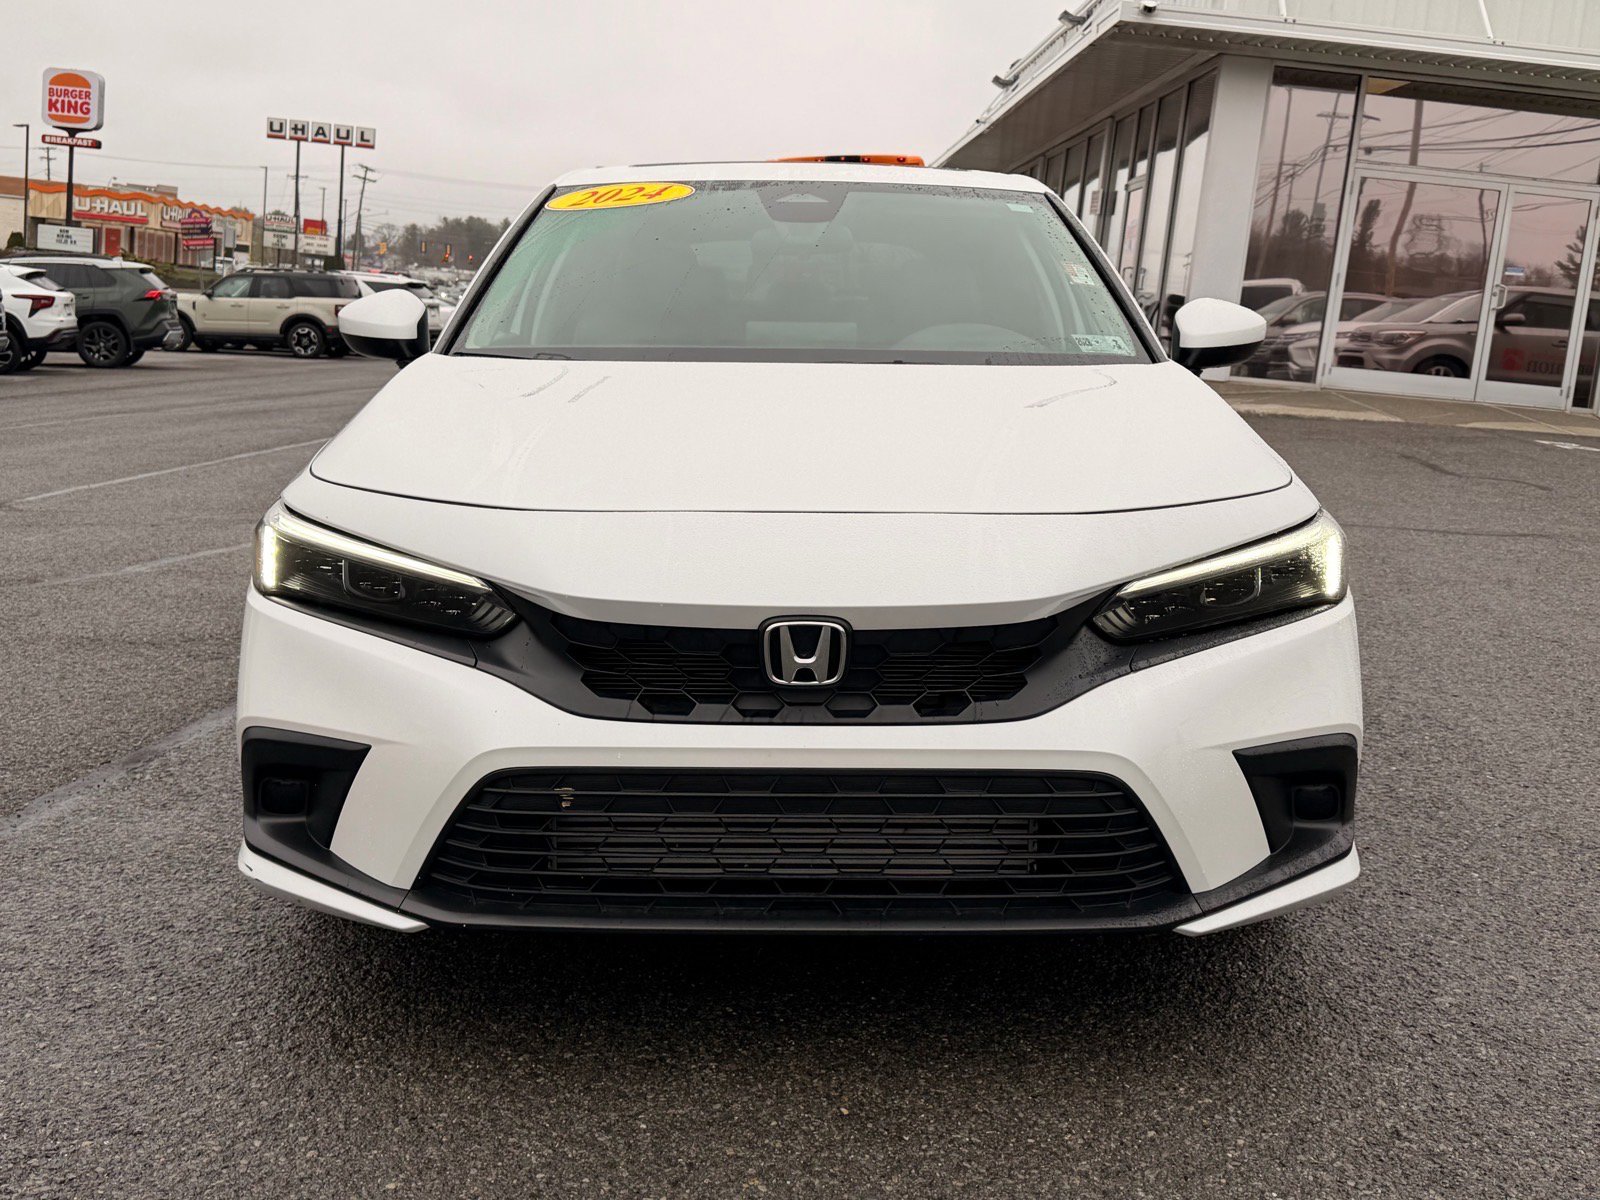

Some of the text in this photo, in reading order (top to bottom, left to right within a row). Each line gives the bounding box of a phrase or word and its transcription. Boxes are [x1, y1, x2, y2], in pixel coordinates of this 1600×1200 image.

[48, 87, 91, 100] BURGER
[47, 98, 91, 115] KING
[44, 135, 93, 147] BREAKFAST
[567, 184, 673, 207] 2024
[74, 195, 148, 216] U-HAUL
